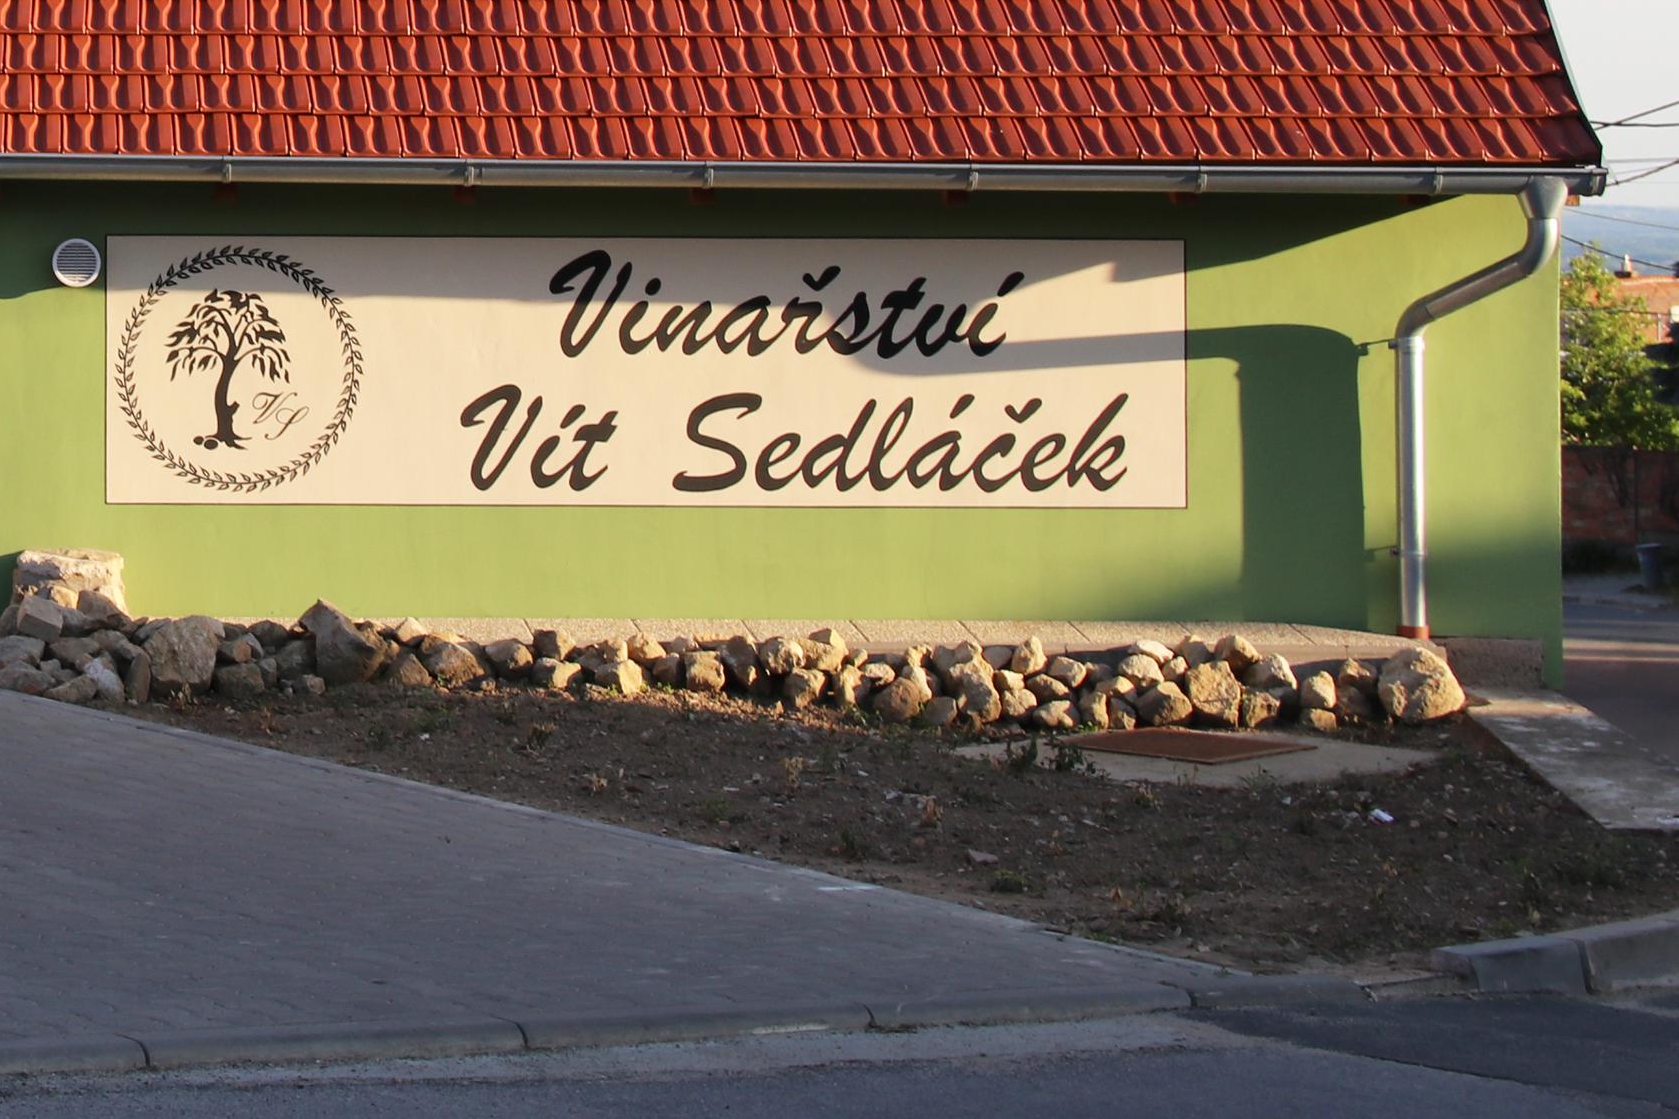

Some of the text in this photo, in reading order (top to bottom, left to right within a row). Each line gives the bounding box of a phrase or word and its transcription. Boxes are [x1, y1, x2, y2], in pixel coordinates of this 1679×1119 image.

[548, 249, 1026, 360] Vinařství
[459, 383, 1131, 494] Vít Sedláček
